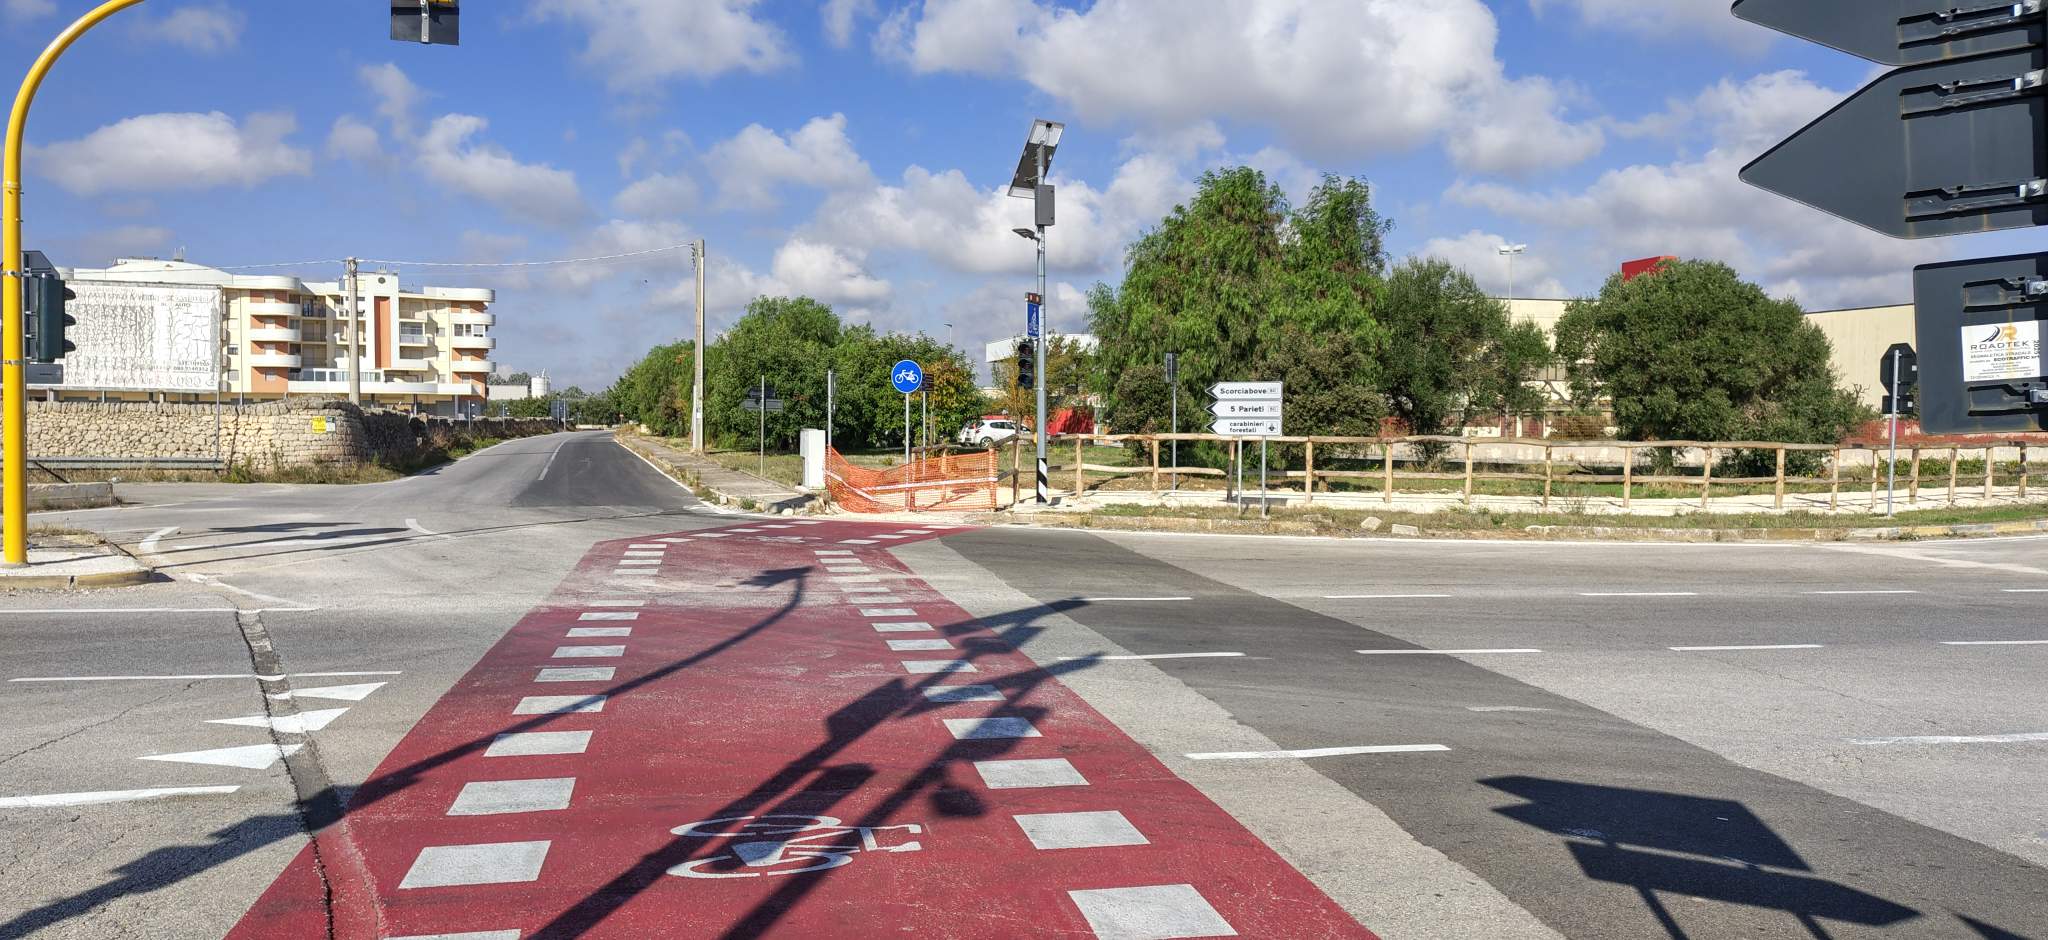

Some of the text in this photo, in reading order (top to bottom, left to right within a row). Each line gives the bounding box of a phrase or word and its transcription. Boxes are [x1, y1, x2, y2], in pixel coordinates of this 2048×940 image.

[1970, 340, 2030, 350] ROADTEK
[1230, 405, 1235, 413] 5
[1238, 405, 1265, 413] Parieti
